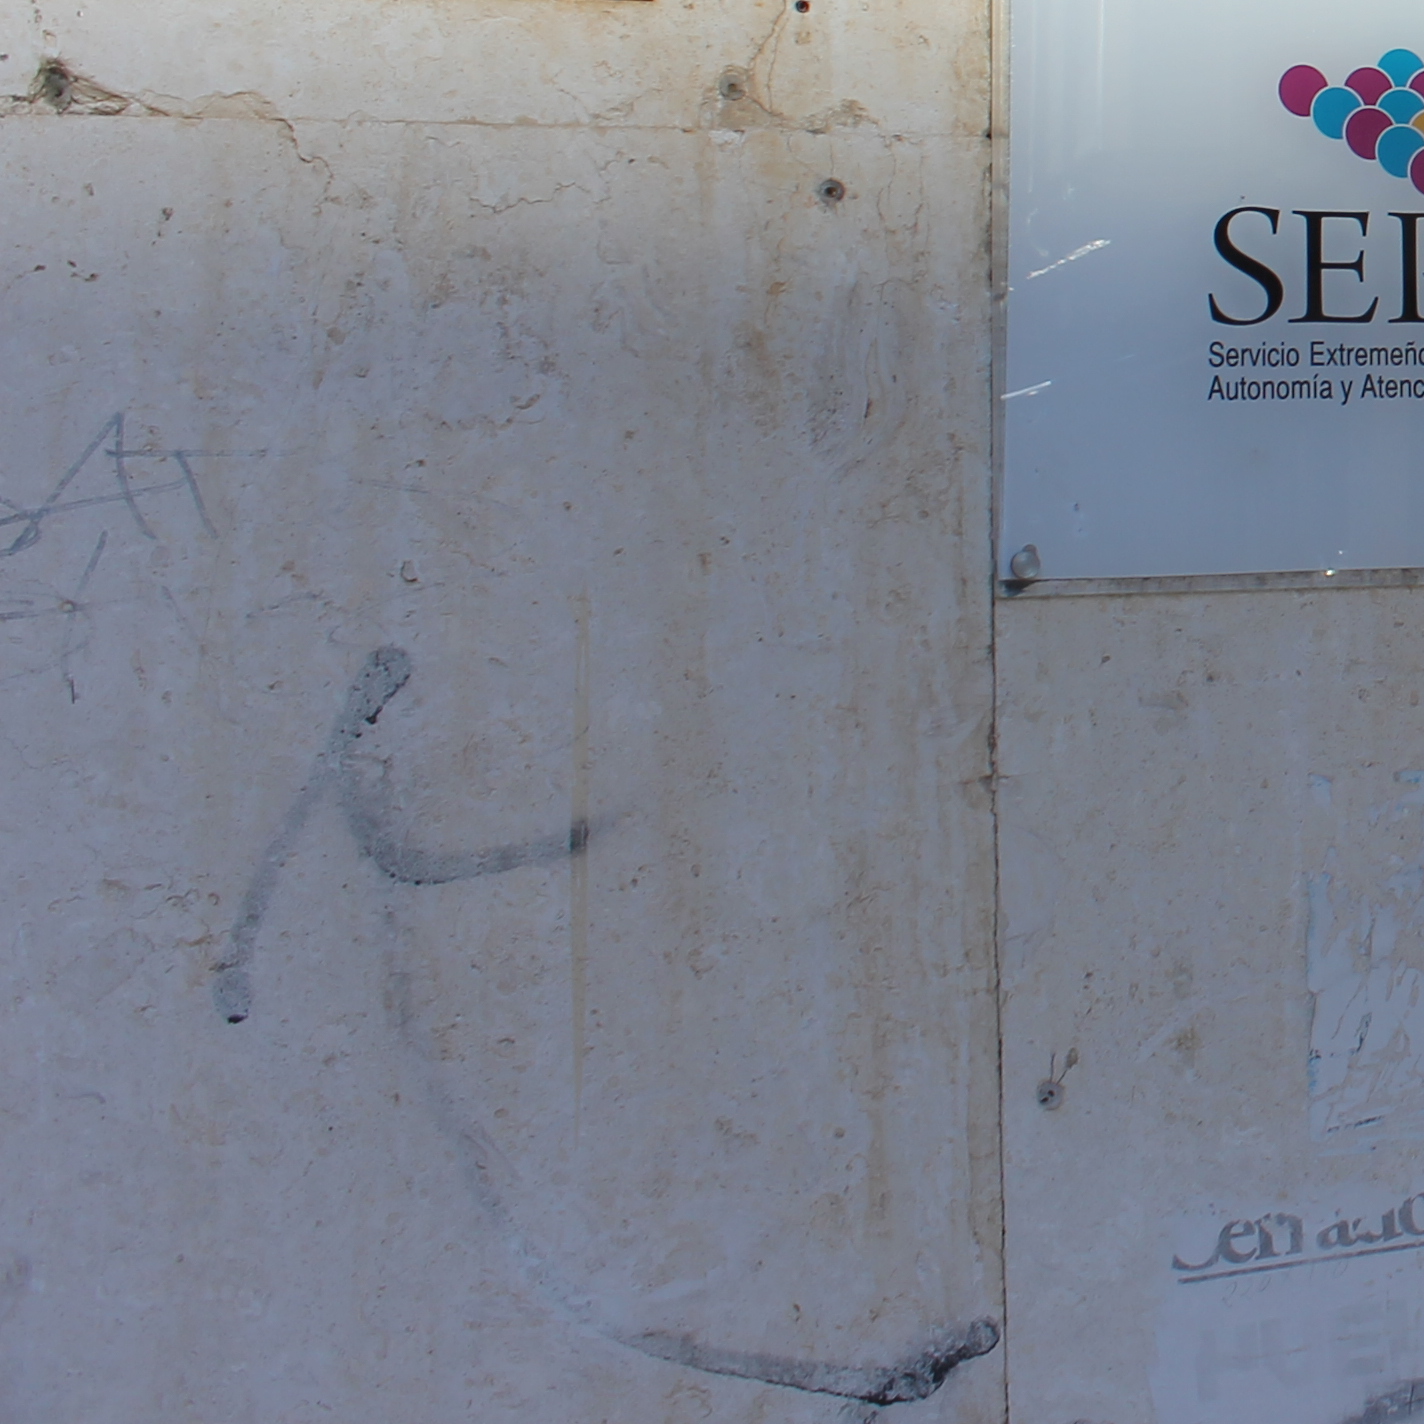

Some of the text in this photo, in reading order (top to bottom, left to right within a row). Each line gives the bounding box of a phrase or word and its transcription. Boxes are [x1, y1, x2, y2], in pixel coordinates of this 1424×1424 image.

[1208, 341, 1300, 368] Servicio
[1207, 373, 1333, 401] Autonomía
[1340, 380, 1353, 406] y
